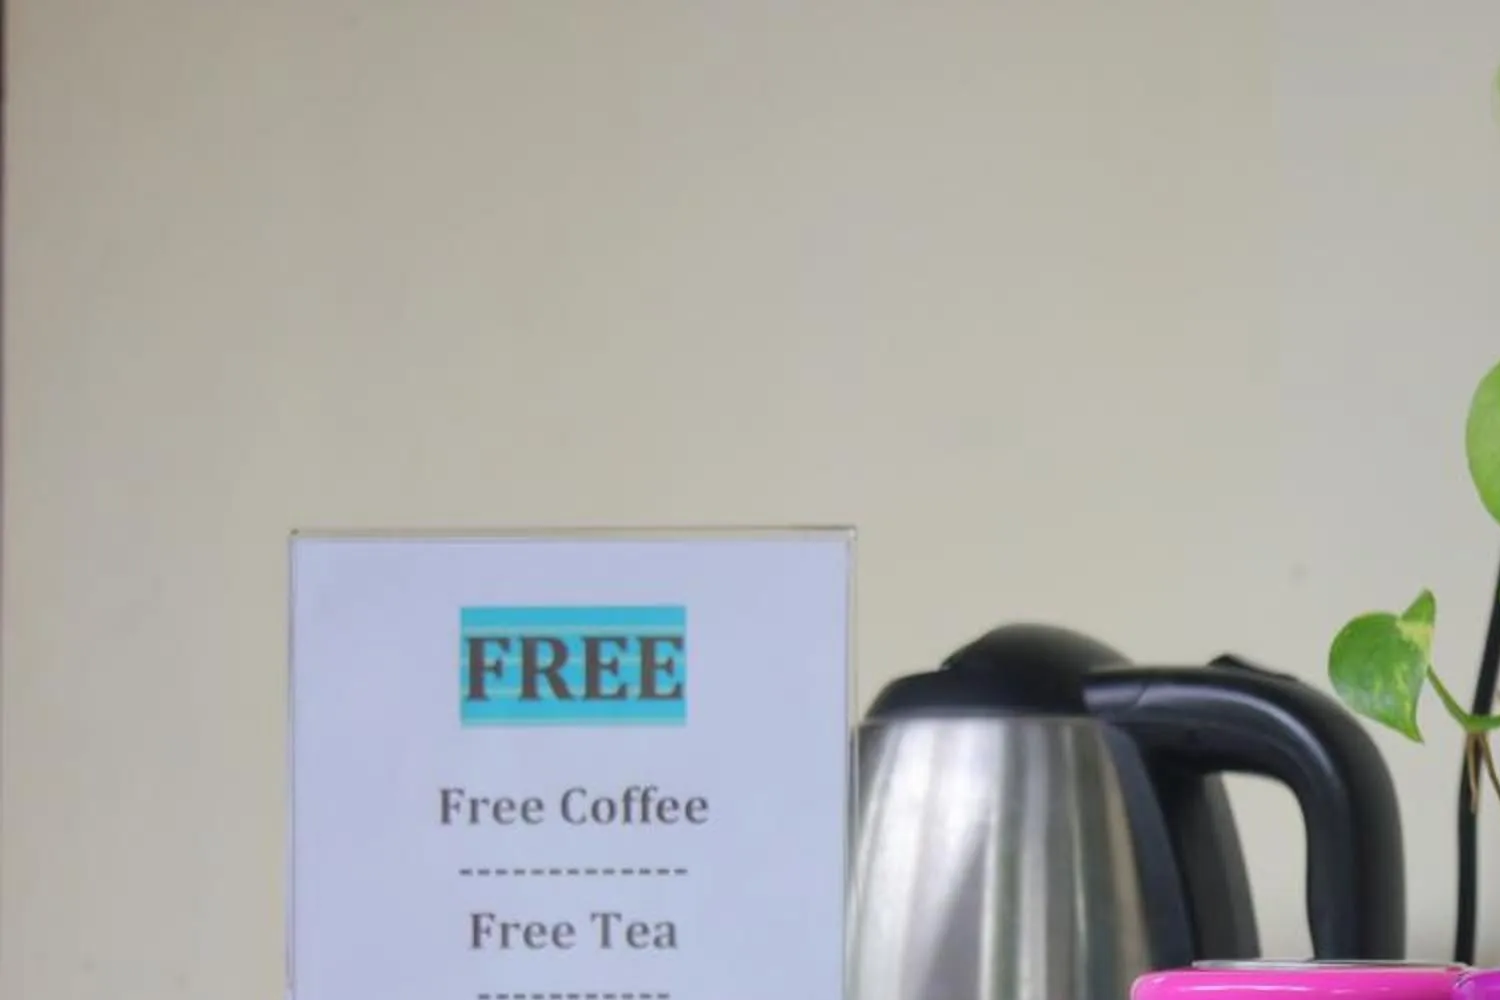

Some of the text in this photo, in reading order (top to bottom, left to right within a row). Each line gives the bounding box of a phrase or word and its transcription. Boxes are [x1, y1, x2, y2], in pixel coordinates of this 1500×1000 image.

[465, 635, 685, 702] FREE
[439, 785, 710, 826] Free Coffee
[469, 911, 679, 951] Free Tea
